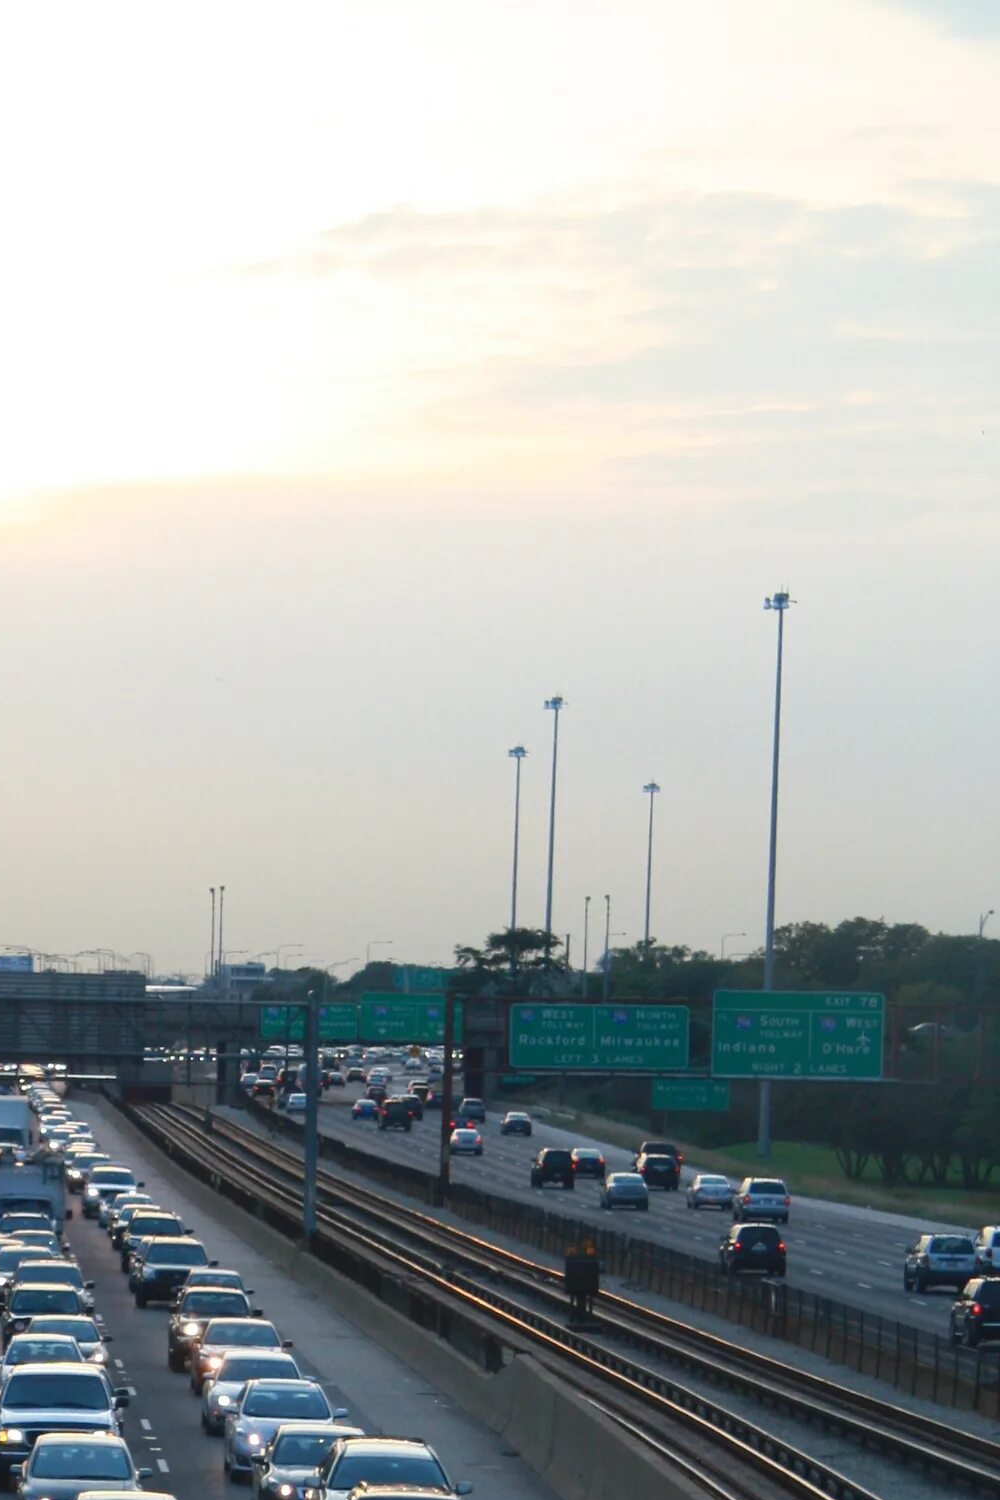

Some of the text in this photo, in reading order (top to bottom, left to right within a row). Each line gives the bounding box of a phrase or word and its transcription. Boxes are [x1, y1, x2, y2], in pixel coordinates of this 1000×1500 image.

[825, 996, 878, 1008] EXIT 78
[541, 1009, 575, 1019] WEST
[636, 1009, 676, 1020] NORTH
[541, 1021, 585, 1029] TOLLWAY
[636, 1022, 680, 1030] TOLLWAY
[759, 1015, 799, 1027] SOUTH
[845, 1017, 878, 1028] WEST
[519, 1034, 586, 1046] Rockford
[760, 1030, 803, 1039] TOLLWAY
[600, 1034, 680, 1047] Milwaukee
[718, 1041, 776, 1053] Indiana
[822, 1042, 871, 1054] O'Hare
[555, 1054, 644, 1064] LEFT 3 LANES
[752, 1062, 848, 1074] RIGHT 2 LANES
